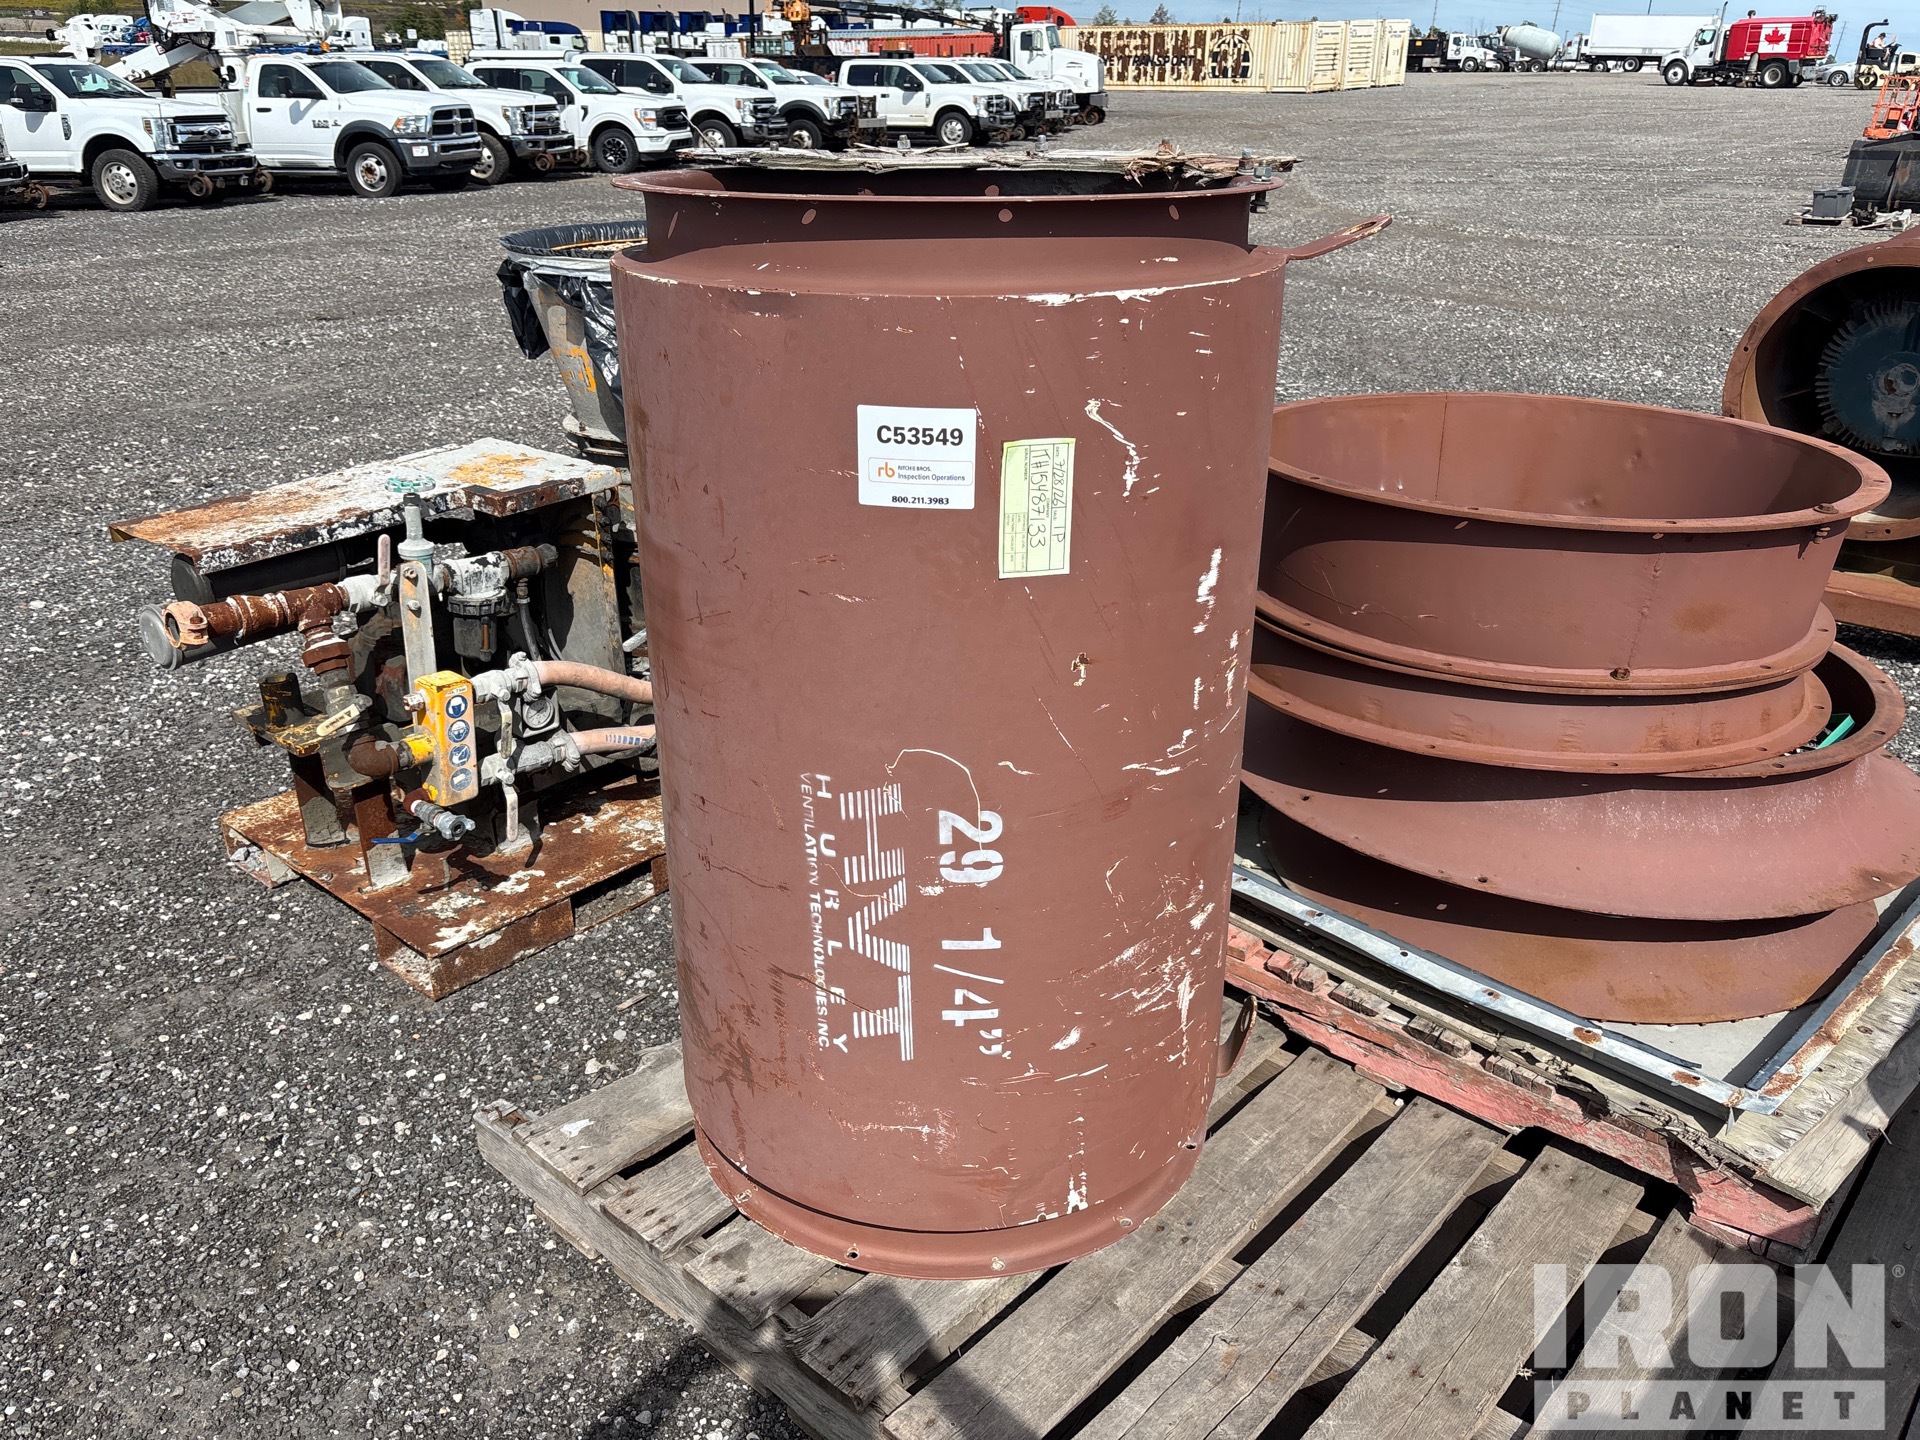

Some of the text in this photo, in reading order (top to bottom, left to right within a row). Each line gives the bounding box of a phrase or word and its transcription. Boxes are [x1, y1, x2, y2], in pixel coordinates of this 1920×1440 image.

[1128, 55, 1195, 67] TRANSPORT
[876, 425, 964, 447] C53549
[892, 496, 949, 505] 800.211.3983
[938, 810, 1004, 883] 29
[800, 773, 829, 1051] VENTILATION TECHNOLOGIES INC.
[816, 774, 848, 1053] HURLEY
[840, 783, 913, 1062] HVT
